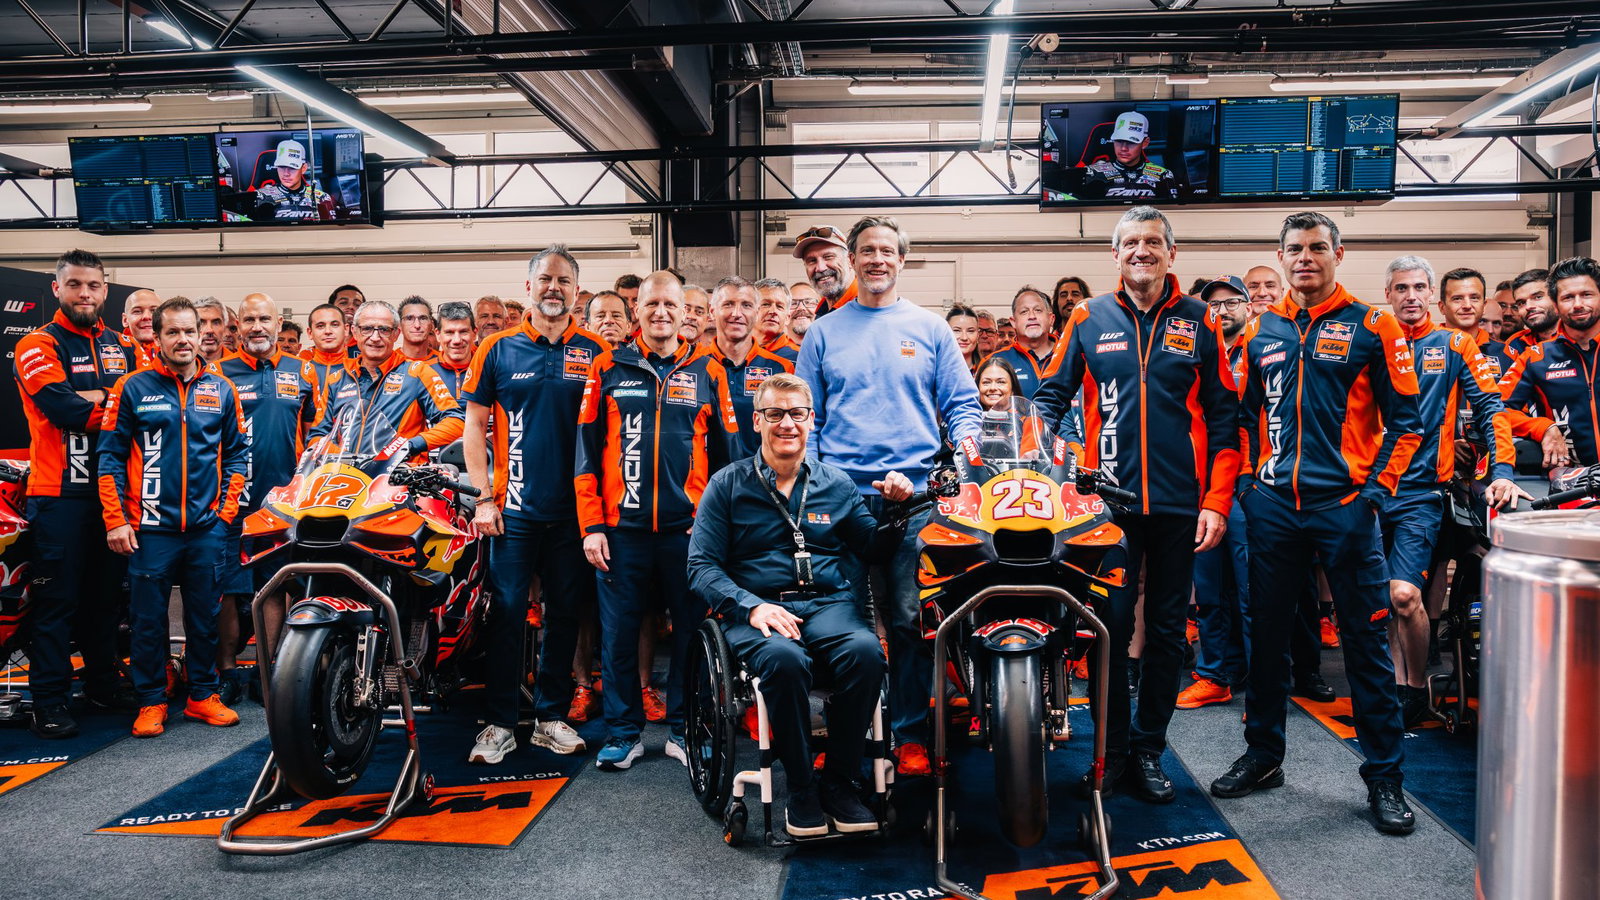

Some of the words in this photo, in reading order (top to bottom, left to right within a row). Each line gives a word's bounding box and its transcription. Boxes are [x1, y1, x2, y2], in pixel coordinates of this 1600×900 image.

[4, 300, 36, 313] WP
[1098, 332, 1125, 341] WP
[1098, 342, 1126, 352] MOTUL
[1262, 341, 1284, 353] WP
[1320, 343, 1345, 352] KTM
[1262, 353, 1285, 365] MOTUL
[511, 372, 536, 380] WP
[1547, 370, 1577, 379] MOTUL
[239, 392, 257, 400] OTUL
[383, 436, 406, 457] MOTUL
[962, 436, 979, 462] MOTUL
[1054, 437, 1067, 462] MOTUL
[70, 433, 89, 483] RAC
[295, 473, 367, 511] 12
[992, 478, 1054, 520] 23
[1369, 608, 1390, 622] KTM
[478, 771, 562, 782] KTM.COM
[119, 811, 192, 826] READY
[200, 808, 230, 819] TO
[233, 803, 292, 816] RE
[1137, 831, 1225, 850] KTM.COM
